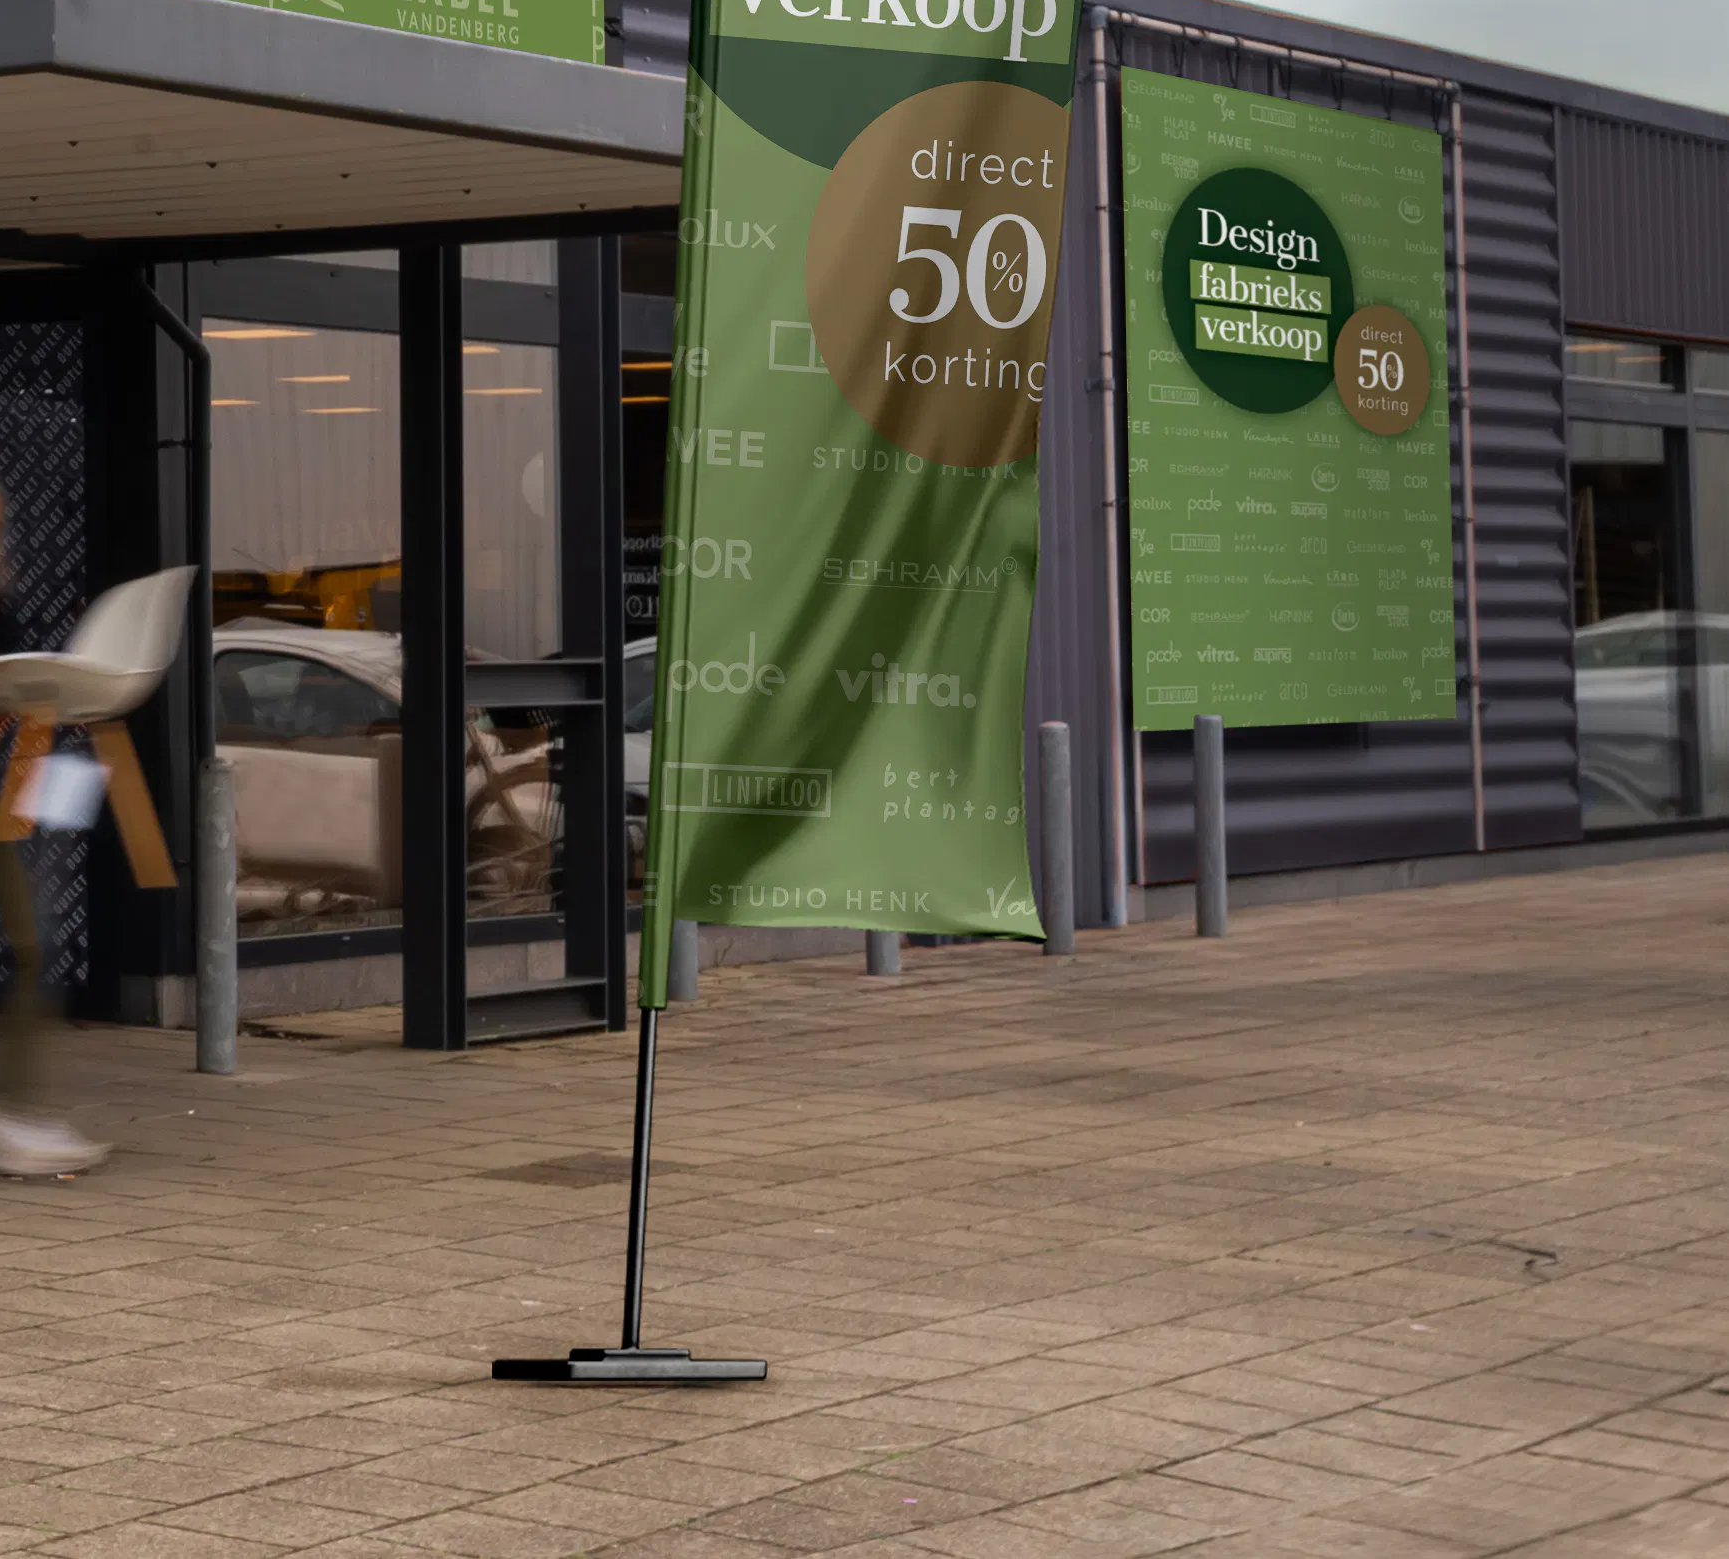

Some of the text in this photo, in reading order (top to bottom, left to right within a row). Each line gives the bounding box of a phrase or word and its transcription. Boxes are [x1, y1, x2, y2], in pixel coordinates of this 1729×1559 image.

[397, 8, 520, 45] VANDENBERG
[1208, 131, 1251, 150] HAVEE
[912, 140, 1053, 188] direct
[1198, 208, 1319, 271] Design
[1199, 263, 1322, 312] fabrieks
[1200, 311, 1322, 361] verkoop
[1361, 326, 1403, 344] direct
[884, 341, 1047, 402] korting
[1358, 395, 1408, 415] korting
[813, 447, 923, 474] STUDIO
[1396, 442, 1435, 455] HAVEE
[1404, 475, 1428, 488] COR
[661, 536, 752, 580] COR
[823, 557, 997, 588] SCHRAMM
[1141, 608, 1170, 624] COR
[667, 632, 786, 722] pode
[713, 774, 821, 808] LINTELOO
[883, 763, 958, 788] bert
[53, 876, 87, 914] OUTLET
[709, 884, 930, 912] STUDIO HENK
